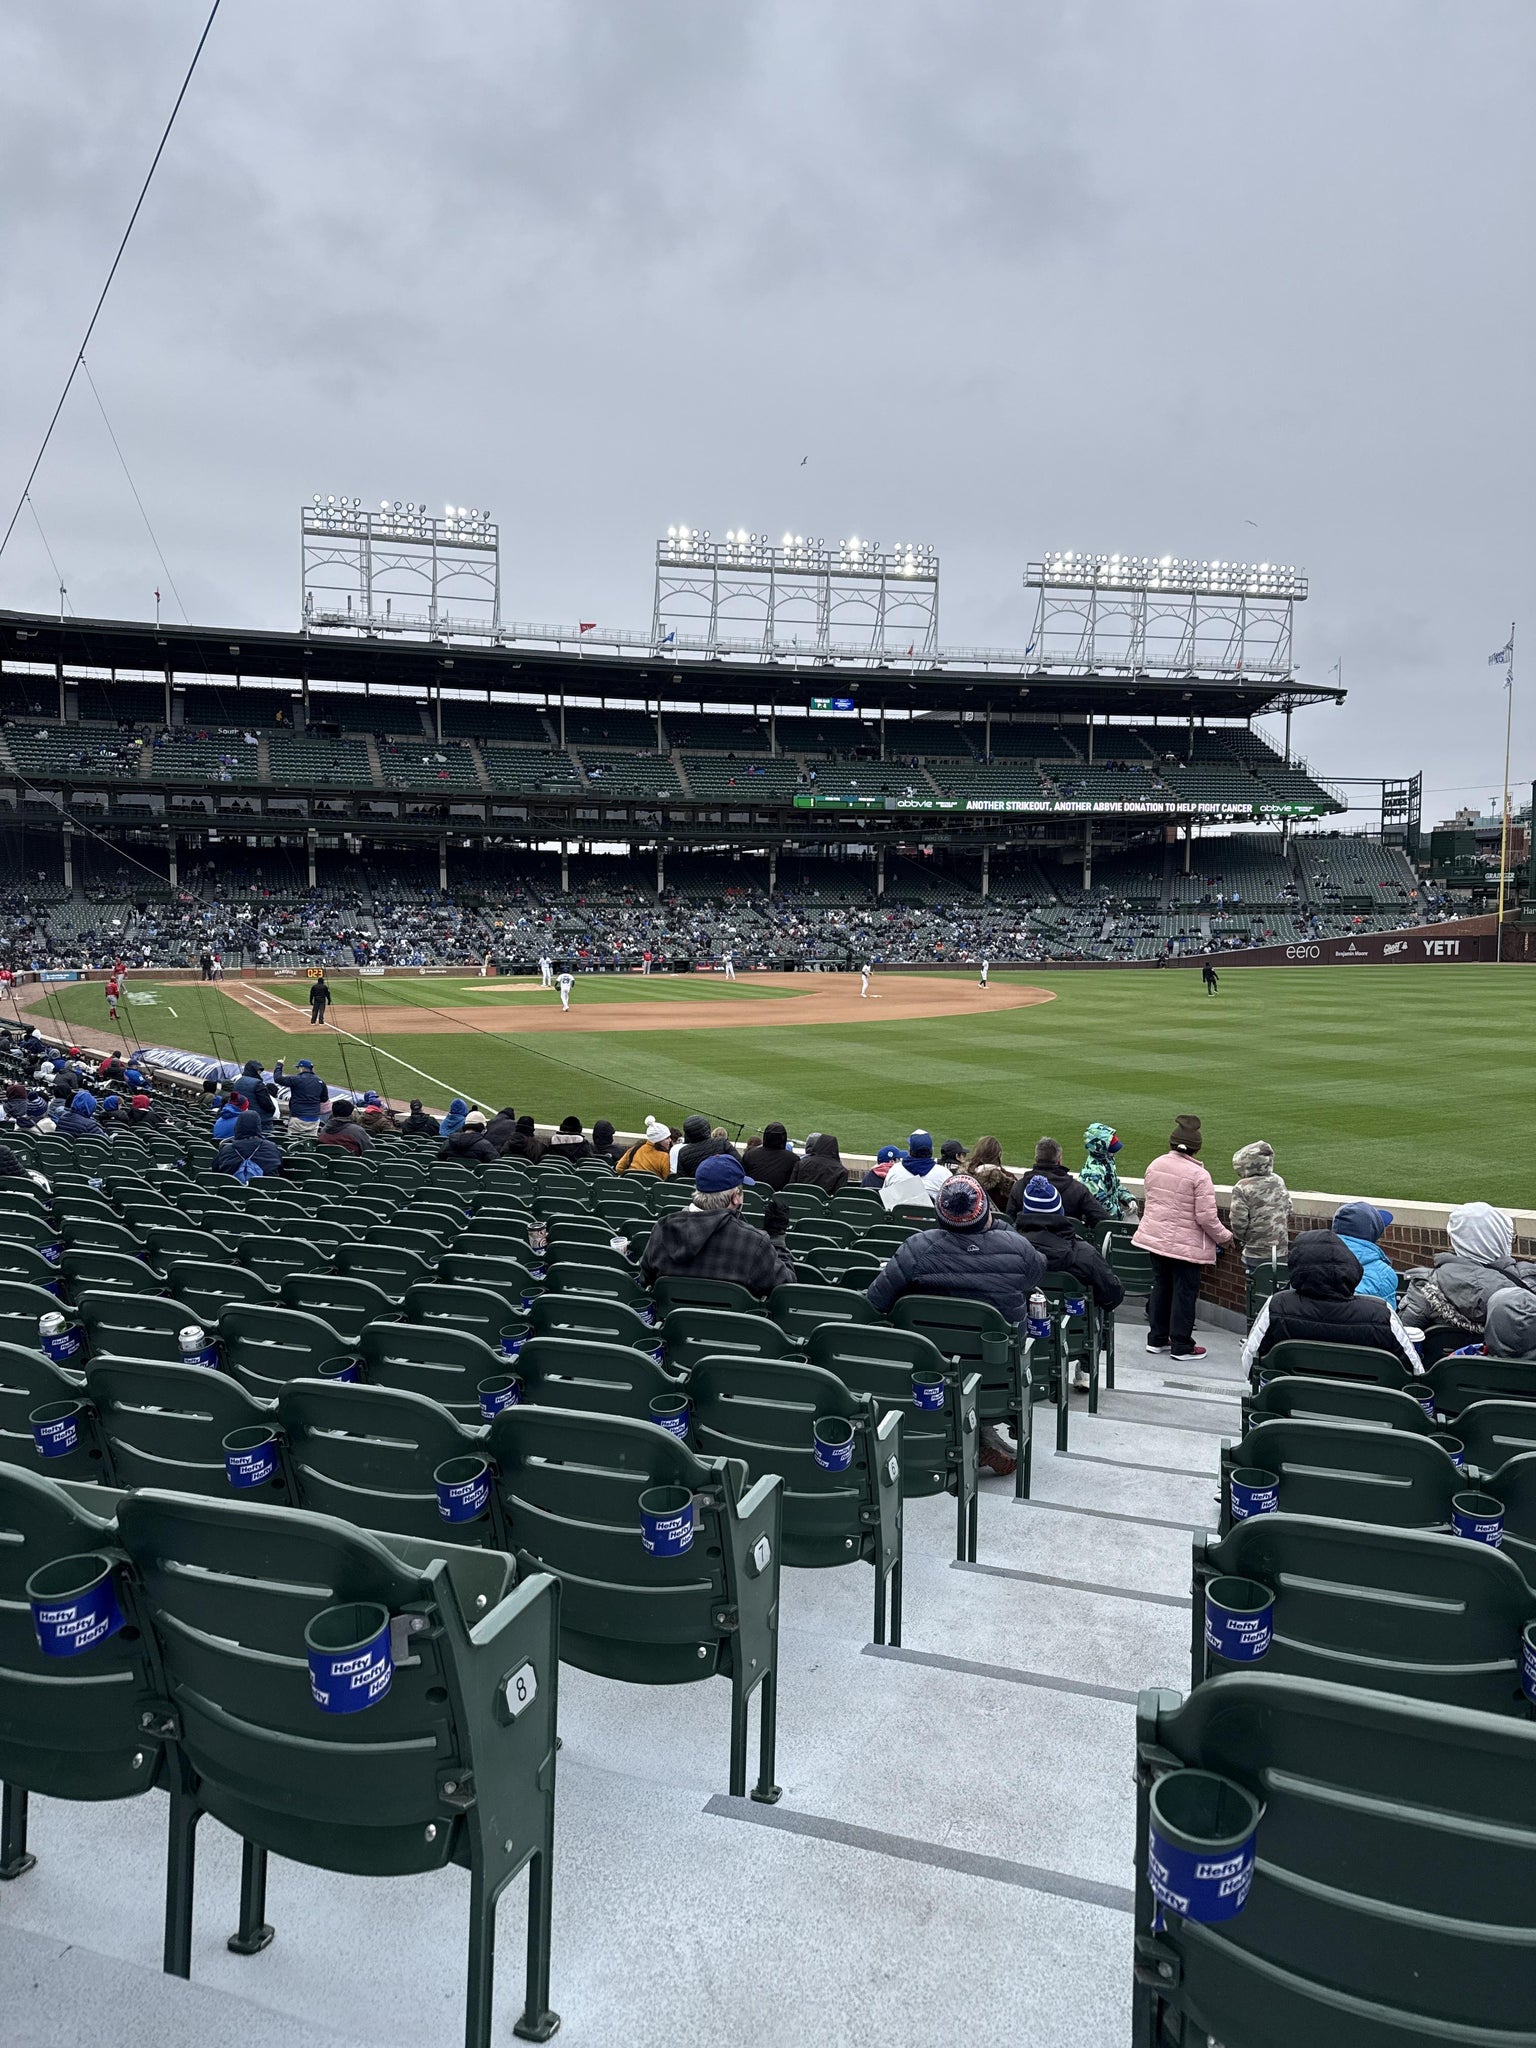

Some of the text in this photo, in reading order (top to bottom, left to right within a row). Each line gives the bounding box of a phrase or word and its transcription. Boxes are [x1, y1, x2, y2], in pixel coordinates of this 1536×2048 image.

[897, 800, 933, 808] abbvie
[966, 801, 1005, 810] ANOTHER
[1006, 801, 1052, 811] STRIKEOUT,
[1054, 802, 1092, 811] ANOTHER
[1093, 802, 1123, 811] ABBVIE
[1124, 802, 1163, 812] DONATION
[1165, 803, 1176, 812] TO
[1177, 803, 1196, 812] HELP
[1198, 803, 1220, 812] FIGHT
[1221, 803, 1252, 813] CANCER
[1260, 804, 1292, 812] abbvie
[1286, 945, 1320, 959] eero
[1422, 940, 1460, 956] YETI
[42, 1425, 63, 1434] Hefty
[55, 1428, 75, 1440] Hefty
[241, 1463, 263, 1473] Hefty
[451, 1485, 473, 1496] Hefty
[657, 1520, 681, 1529] Hefty
[670, 1526, 690, 1539] Hefty
[758, 1544, 764, 1562] 7
[41, 1610, 74, 1621] Hefty
[59, 1617, 93, 1634] Hefty
[1228, 1621, 1257, 1630] Hefty
[78, 1623, 108, 1644] Hefty
[1242, 1631, 1267, 1641] Hefty
[333, 1658, 369, 1673] Hefty
[353, 1663, 384, 1686] Hefty
[516, 1677, 527, 1701] 8
[1199, 1862, 1241, 1876] Hefty
